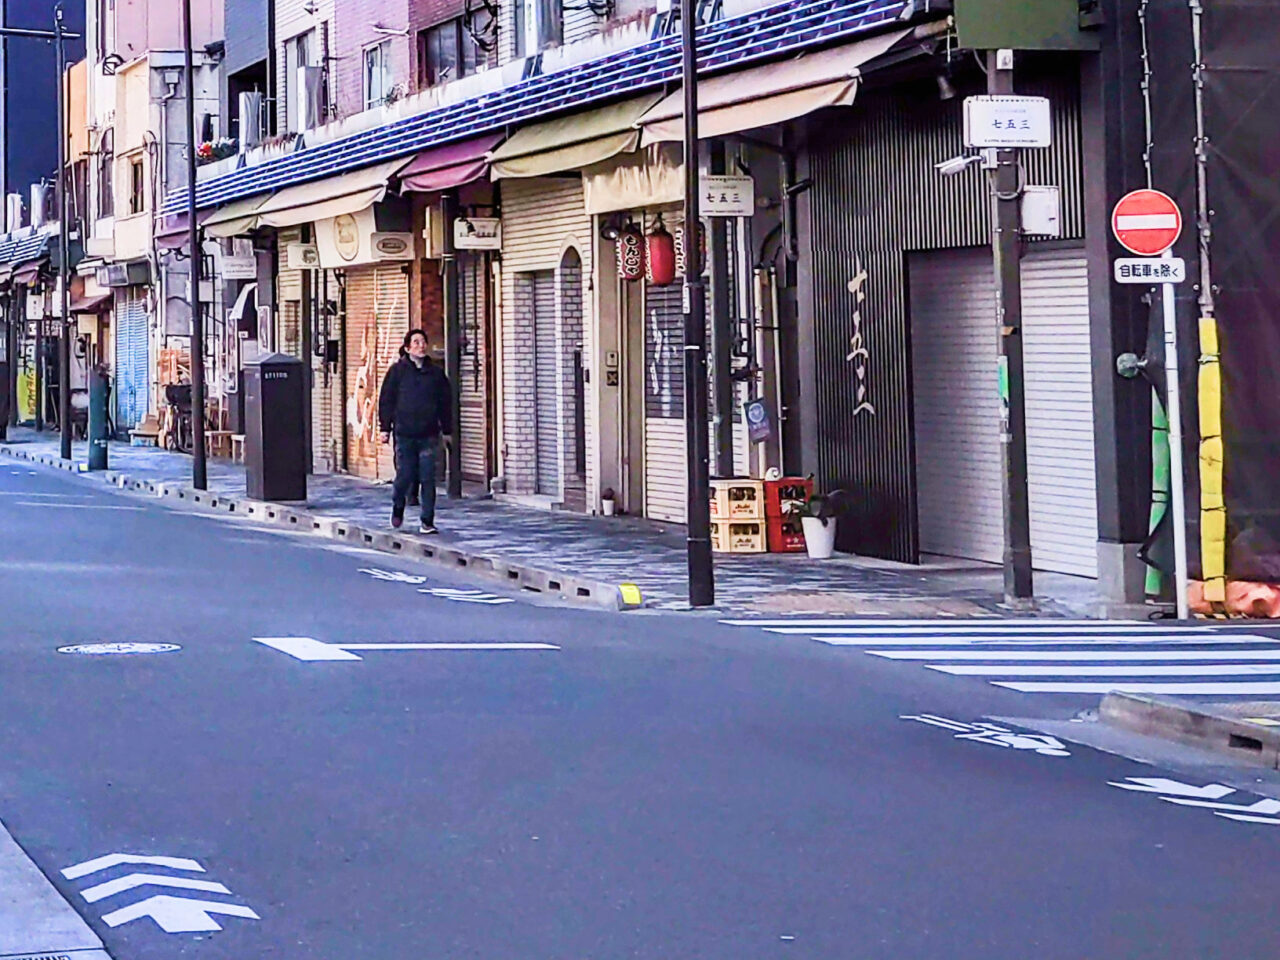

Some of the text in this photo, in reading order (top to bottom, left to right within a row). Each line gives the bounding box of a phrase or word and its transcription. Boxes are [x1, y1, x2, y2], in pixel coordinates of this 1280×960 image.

[991, 119, 1031, 130] 七五三
[706, 192, 741, 203] 七五三
[1119, 264, 1179, 278] 自転車を除く
